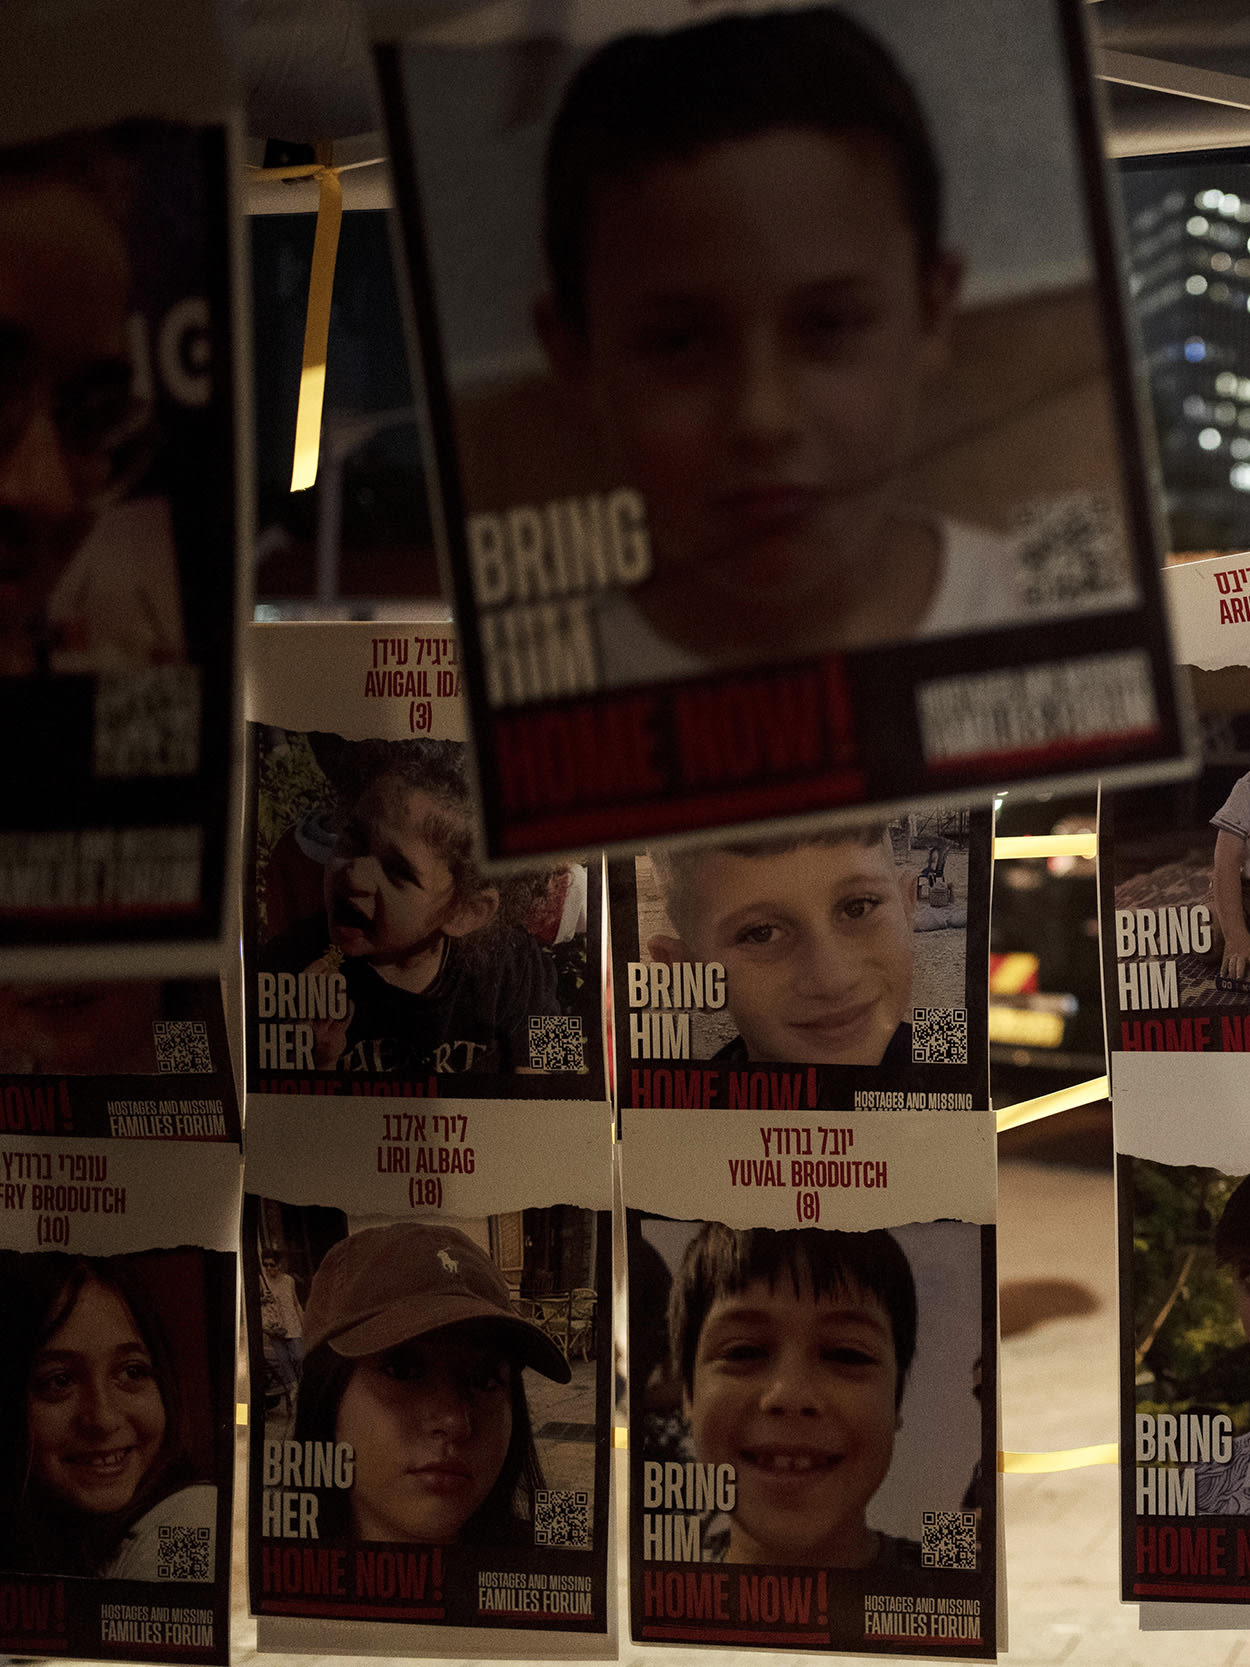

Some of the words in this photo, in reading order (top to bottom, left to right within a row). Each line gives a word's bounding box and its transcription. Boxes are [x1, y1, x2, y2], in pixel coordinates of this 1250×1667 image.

[465, 489, 653, 604] BRING
[372, 639, 408, 668] עידן
[415, 637, 459, 666] ביגיל
[482, 604, 599, 708] HIM
[365, 671, 432, 697] AVIGAIL
[409, 701, 433, 732] (3)
[1115, 905, 1212, 957] BRING
[257, 971, 348, 1020] BRING
[627, 962, 727, 1009] BRING
[1118, 960, 1179, 1011] HIM
[257, 1022, 316, 1071] HER
[629, 1013, 691, 1060] HIM
[1121, 1017, 1211, 1051] HOME
[631, 1068, 719, 1109] HOME
[728, 1067, 817, 1110] NOW!
[854, 1090, 904, 1109] HOSTAGES
[906, 1092, 926, 1109] AND
[928, 1092, 973, 1110] MISSING
[0, 1080, 75, 1131] OW!
[107, 1100, 158, 1116] HOSTAGES
[158, 1101, 178, 1116] AND
[179, 1101, 224, 1116] MISSING
[109, 1114, 173, 1137] FAMILIES
[176, 1115, 227, 1137] FORUM
[382, 1113, 427, 1142] אלבג
[432, 1114, 468, 1143] לירי
[817, 1126, 854, 1155] יובל
[760, 1127, 811, 1157] ברודץ
[2, 1151, 52, 1181] ברודץ
[58, 1154, 107, 1182] עופרי
[377, 1146, 410, 1173] LIRI
[416, 1147, 475, 1174] ALBAG
[728, 1160, 786, 1187] YUVAL
[791, 1161, 888, 1189] BRODUTCH
[32, 1184, 126, 1214] BRODUTCH
[409, 1177, 443, 1208] (18)
[796, 1192, 821, 1223] (8)
[37, 1214, 70, 1246] (10)
[1136, 1413, 1233, 1464] BRING
[262, 1440, 355, 1489] BRING
[643, 1461, 736, 1511] BRING
[1136, 1467, 1196, 1517] HIM
[262, 1491, 320, 1540] HER
[643, 1513, 701, 1563] HIM
[1136, 1526, 1227, 1576] HOME
[262, 1547, 346, 1597] HOME
[355, 1547, 444, 1601] NOW!
[478, 1571, 528, 1590] HOSTAGES
[528, 1574, 549, 1590] AND
[549, 1575, 592, 1592] MISSING
[0, 1582, 66, 1633] OW!
[478, 1588, 540, 1612] FAMILIES
[543, 1590, 592, 1615] FORUM
[643, 1571, 730, 1622] HOME
[739, 1570, 829, 1626] NOW!
[864, 1595, 914, 1613] HOSTAGES
[915, 1597, 936, 1614] AND
[936, 1598, 982, 1616] MISSING
[101, 1604, 149, 1621] HOSTAGES
[151, 1607, 170, 1622] AND
[171, 1608, 214, 1625] MISSING
[864, 1612, 928, 1638] FAMILIES
[931, 1614, 982, 1640] FORUM
[101, 1620, 162, 1644] FAMILIES
[165, 1624, 214, 1648] FORUM
